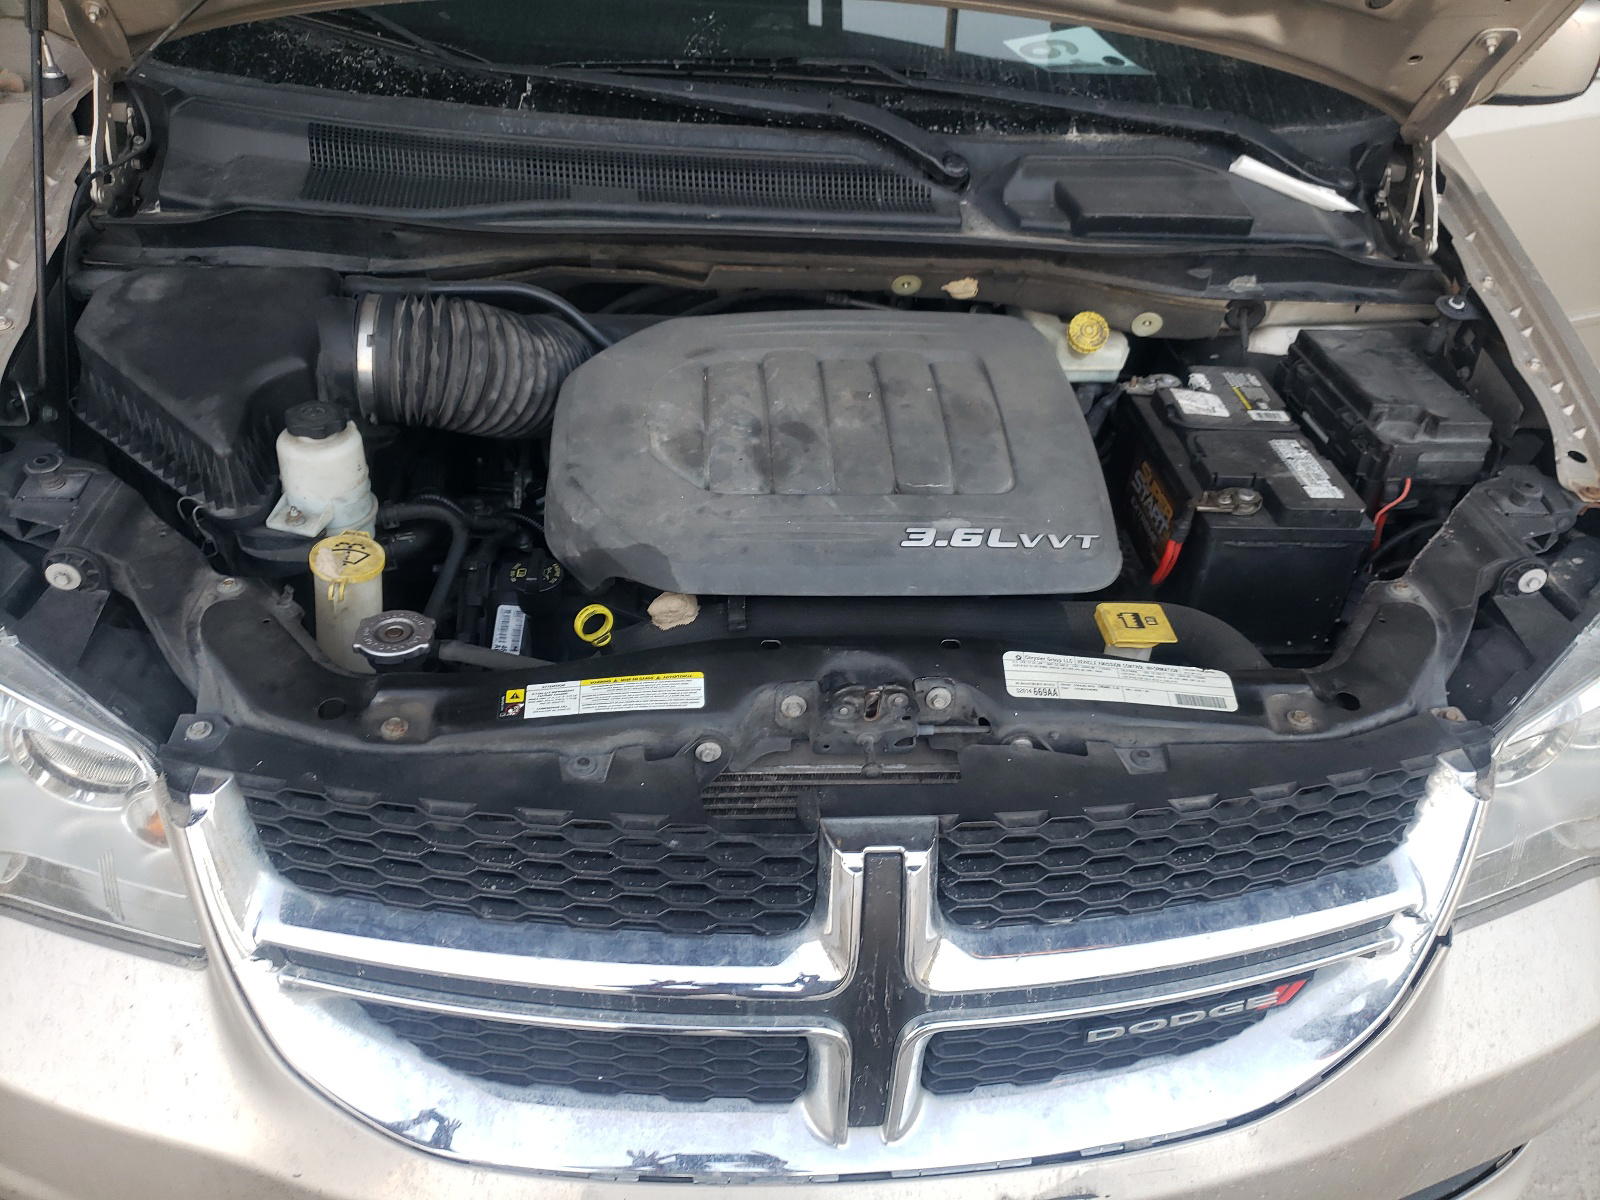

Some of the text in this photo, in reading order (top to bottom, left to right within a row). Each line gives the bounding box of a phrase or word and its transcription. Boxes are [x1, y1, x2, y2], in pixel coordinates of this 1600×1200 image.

[900, 527, 1100, 549] 3.6L VVT
[1087, 991, 1281, 1044] DODGE
